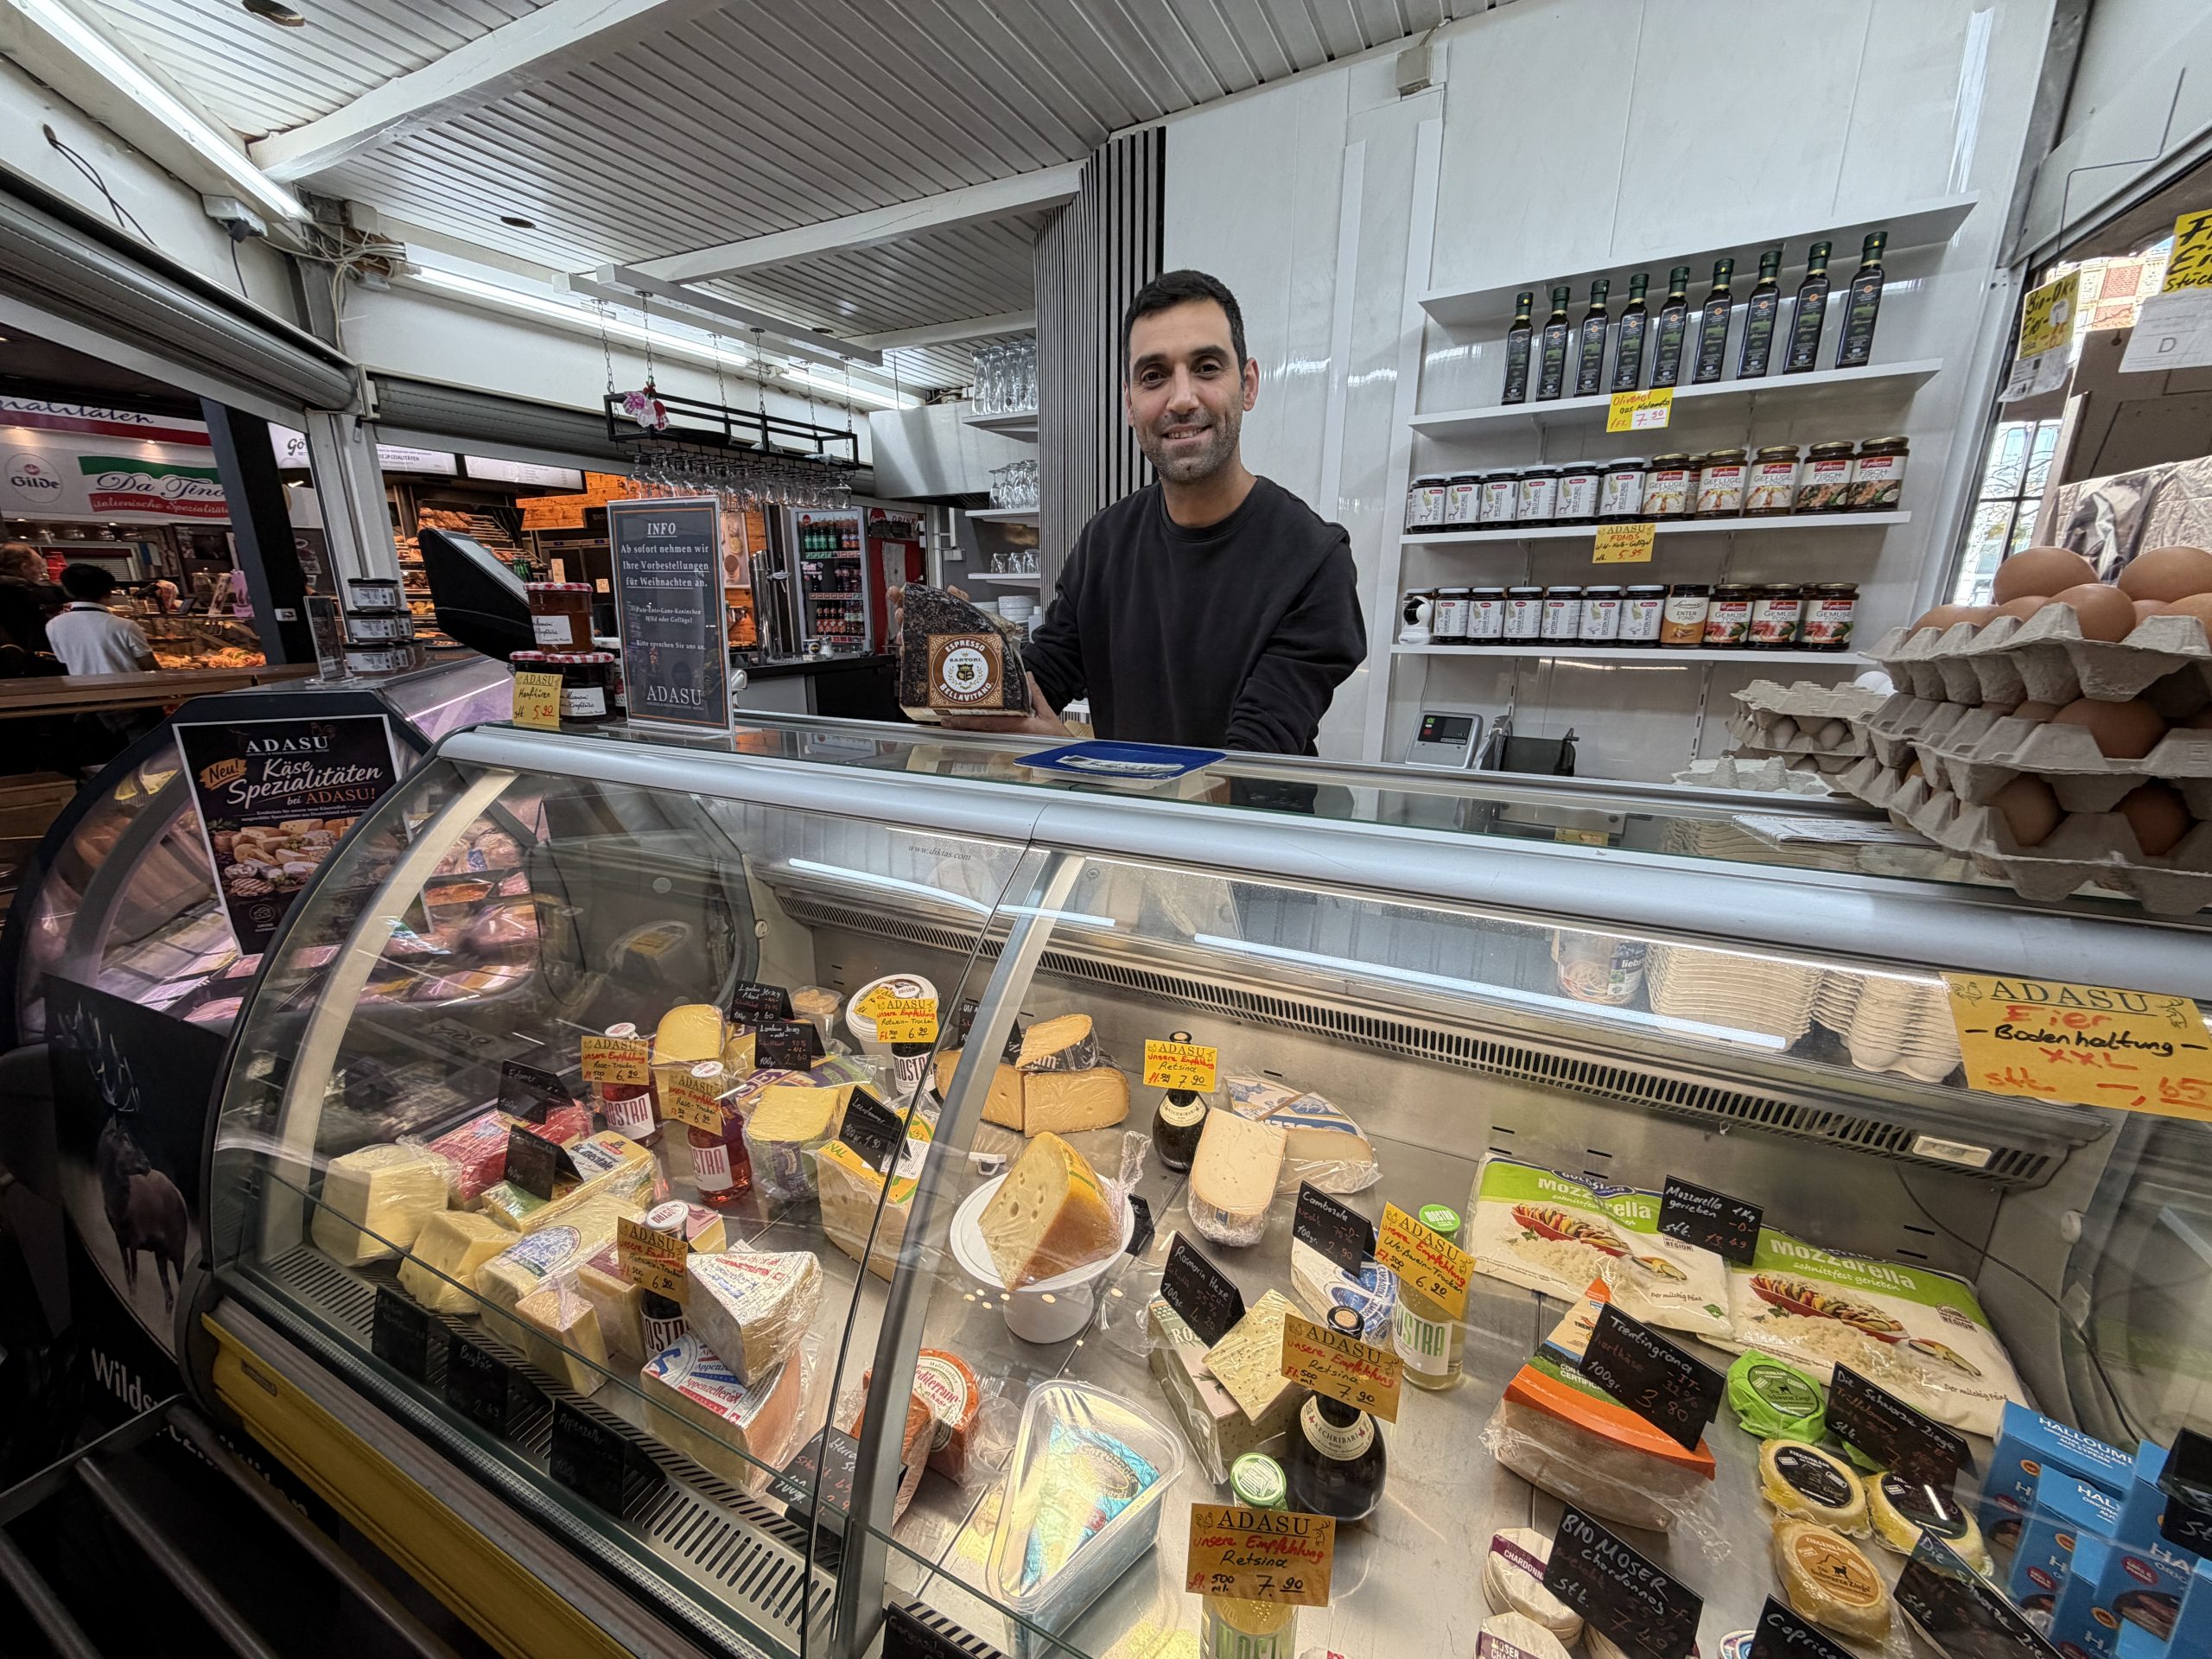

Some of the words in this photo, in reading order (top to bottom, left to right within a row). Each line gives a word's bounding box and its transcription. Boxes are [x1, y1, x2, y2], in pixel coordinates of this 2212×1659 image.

[11, 475, 60, 490] Gilde
[95, 473, 156, 493] Da
[160, 476, 225, 499] Tino
[647, 522, 677, 536] INFO
[1606, 524, 1646, 535] ADASU
[1609, 533, 1640, 542] FONDS
[620, 544, 632, 554] Ab
[633, 544, 658, 554] sofort
[659, 544, 692, 553] nehmen
[694, 544, 709, 554] wir
[622, 561, 639, 570] Ihre
[640, 561, 709, 572] Vorbestellungen
[626, 577, 637, 587] für
[639, 577, 693, 588] Weihnachten
[695, 579, 708, 588] an.
[944, 639, 986, 653] ESPRESSO
[522, 674, 554, 686] ADASU
[646, 685, 702, 706] ADASU
[939, 682, 993, 702] BELLAVITANO
[245, 735, 329, 753] ADASU
[208, 760, 239, 784] Neu!
[263, 758, 313, 781] Käse
[226, 764, 383, 809] Spezialitäten
[287, 795, 302, 806] bei
[305, 787, 376, 804] ADASU!
[908, 844, 972, 862] www.diktas.com
[887, 1000, 926, 1010] ADASU
[1990, 980, 2151, 1014] ADASU
[876, 1009, 898, 1018] unsere
[2003, 1004, 2113, 1029] Eier
[594, 1039, 638, 1051] ADASU
[1159, 1043, 1205, 1058] ADASU
[582, 1052, 606, 1060] unsere
[1147, 1053, 1178, 1062] unsere
[2038, 1046, 2139, 1071] XXL
[1159, 1061, 1197, 1073] Retsina
[678, 1076, 715, 1096] ADASU
[1302, 1191, 1348, 1222] Cambozola
[1666, 1185, 1723, 1211] Mozzarella
[1424, 1210, 1456, 1223] MOSTRA
[1669, 1199, 1718, 1219] gerieben
[629, 1225, 676, 1251] ADASU
[1398, 1217, 1460, 1262] ADASU
[1174, 1245, 1206, 1281] Rosmarin
[1208, 1275, 1230, 1301] Hexe
[1770, 1236, 1917, 1292] Mozzarella
[1793, 1261, 1853, 1283] schnittfest
[1854, 1274, 1903, 1293] gerieben
[1287, 1339, 1325, 1358] unsere
[1305, 1325, 1383, 1367] ADASU
[1300, 1369, 1319, 1380] 500
[1307, 1359, 1361, 1385] Retsina
[1836, 1370, 1855, 1389] Die
[684, 1376, 733, 1401] Appenzeller
[1944, 1383, 1958, 1393] Der
[1313, 1421, 1360, 1445] KECHRIBARI
[2038, 1416, 2133, 1464] HALLOUMI
[1217, 1510, 1312, 1538] ADASU
[1192, 1535, 1237, 1548] unsere
[1219, 1549, 1288, 1569] Retsina
[1560, 1514, 1594, 1544] BIO
[1594, 1537, 1669, 1602] MOSER
[1211, 1573, 1236, 1585] 500
